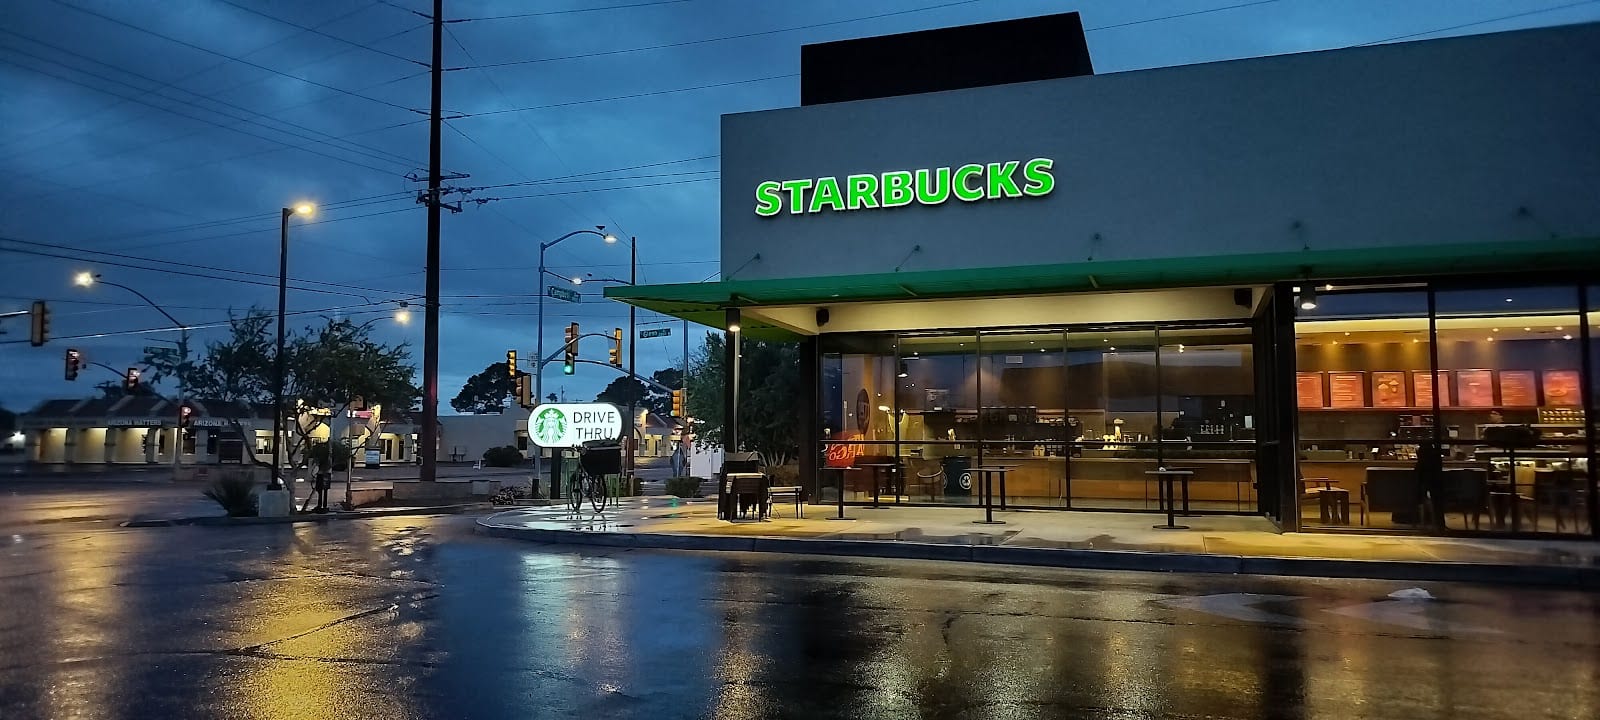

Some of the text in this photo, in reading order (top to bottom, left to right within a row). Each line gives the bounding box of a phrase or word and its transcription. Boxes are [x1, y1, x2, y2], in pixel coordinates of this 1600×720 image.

[755, 157, 1055, 216] STARBUCKS
[573, 411, 615, 424] DRIVE
[575, 427, 613, 440] THRU
